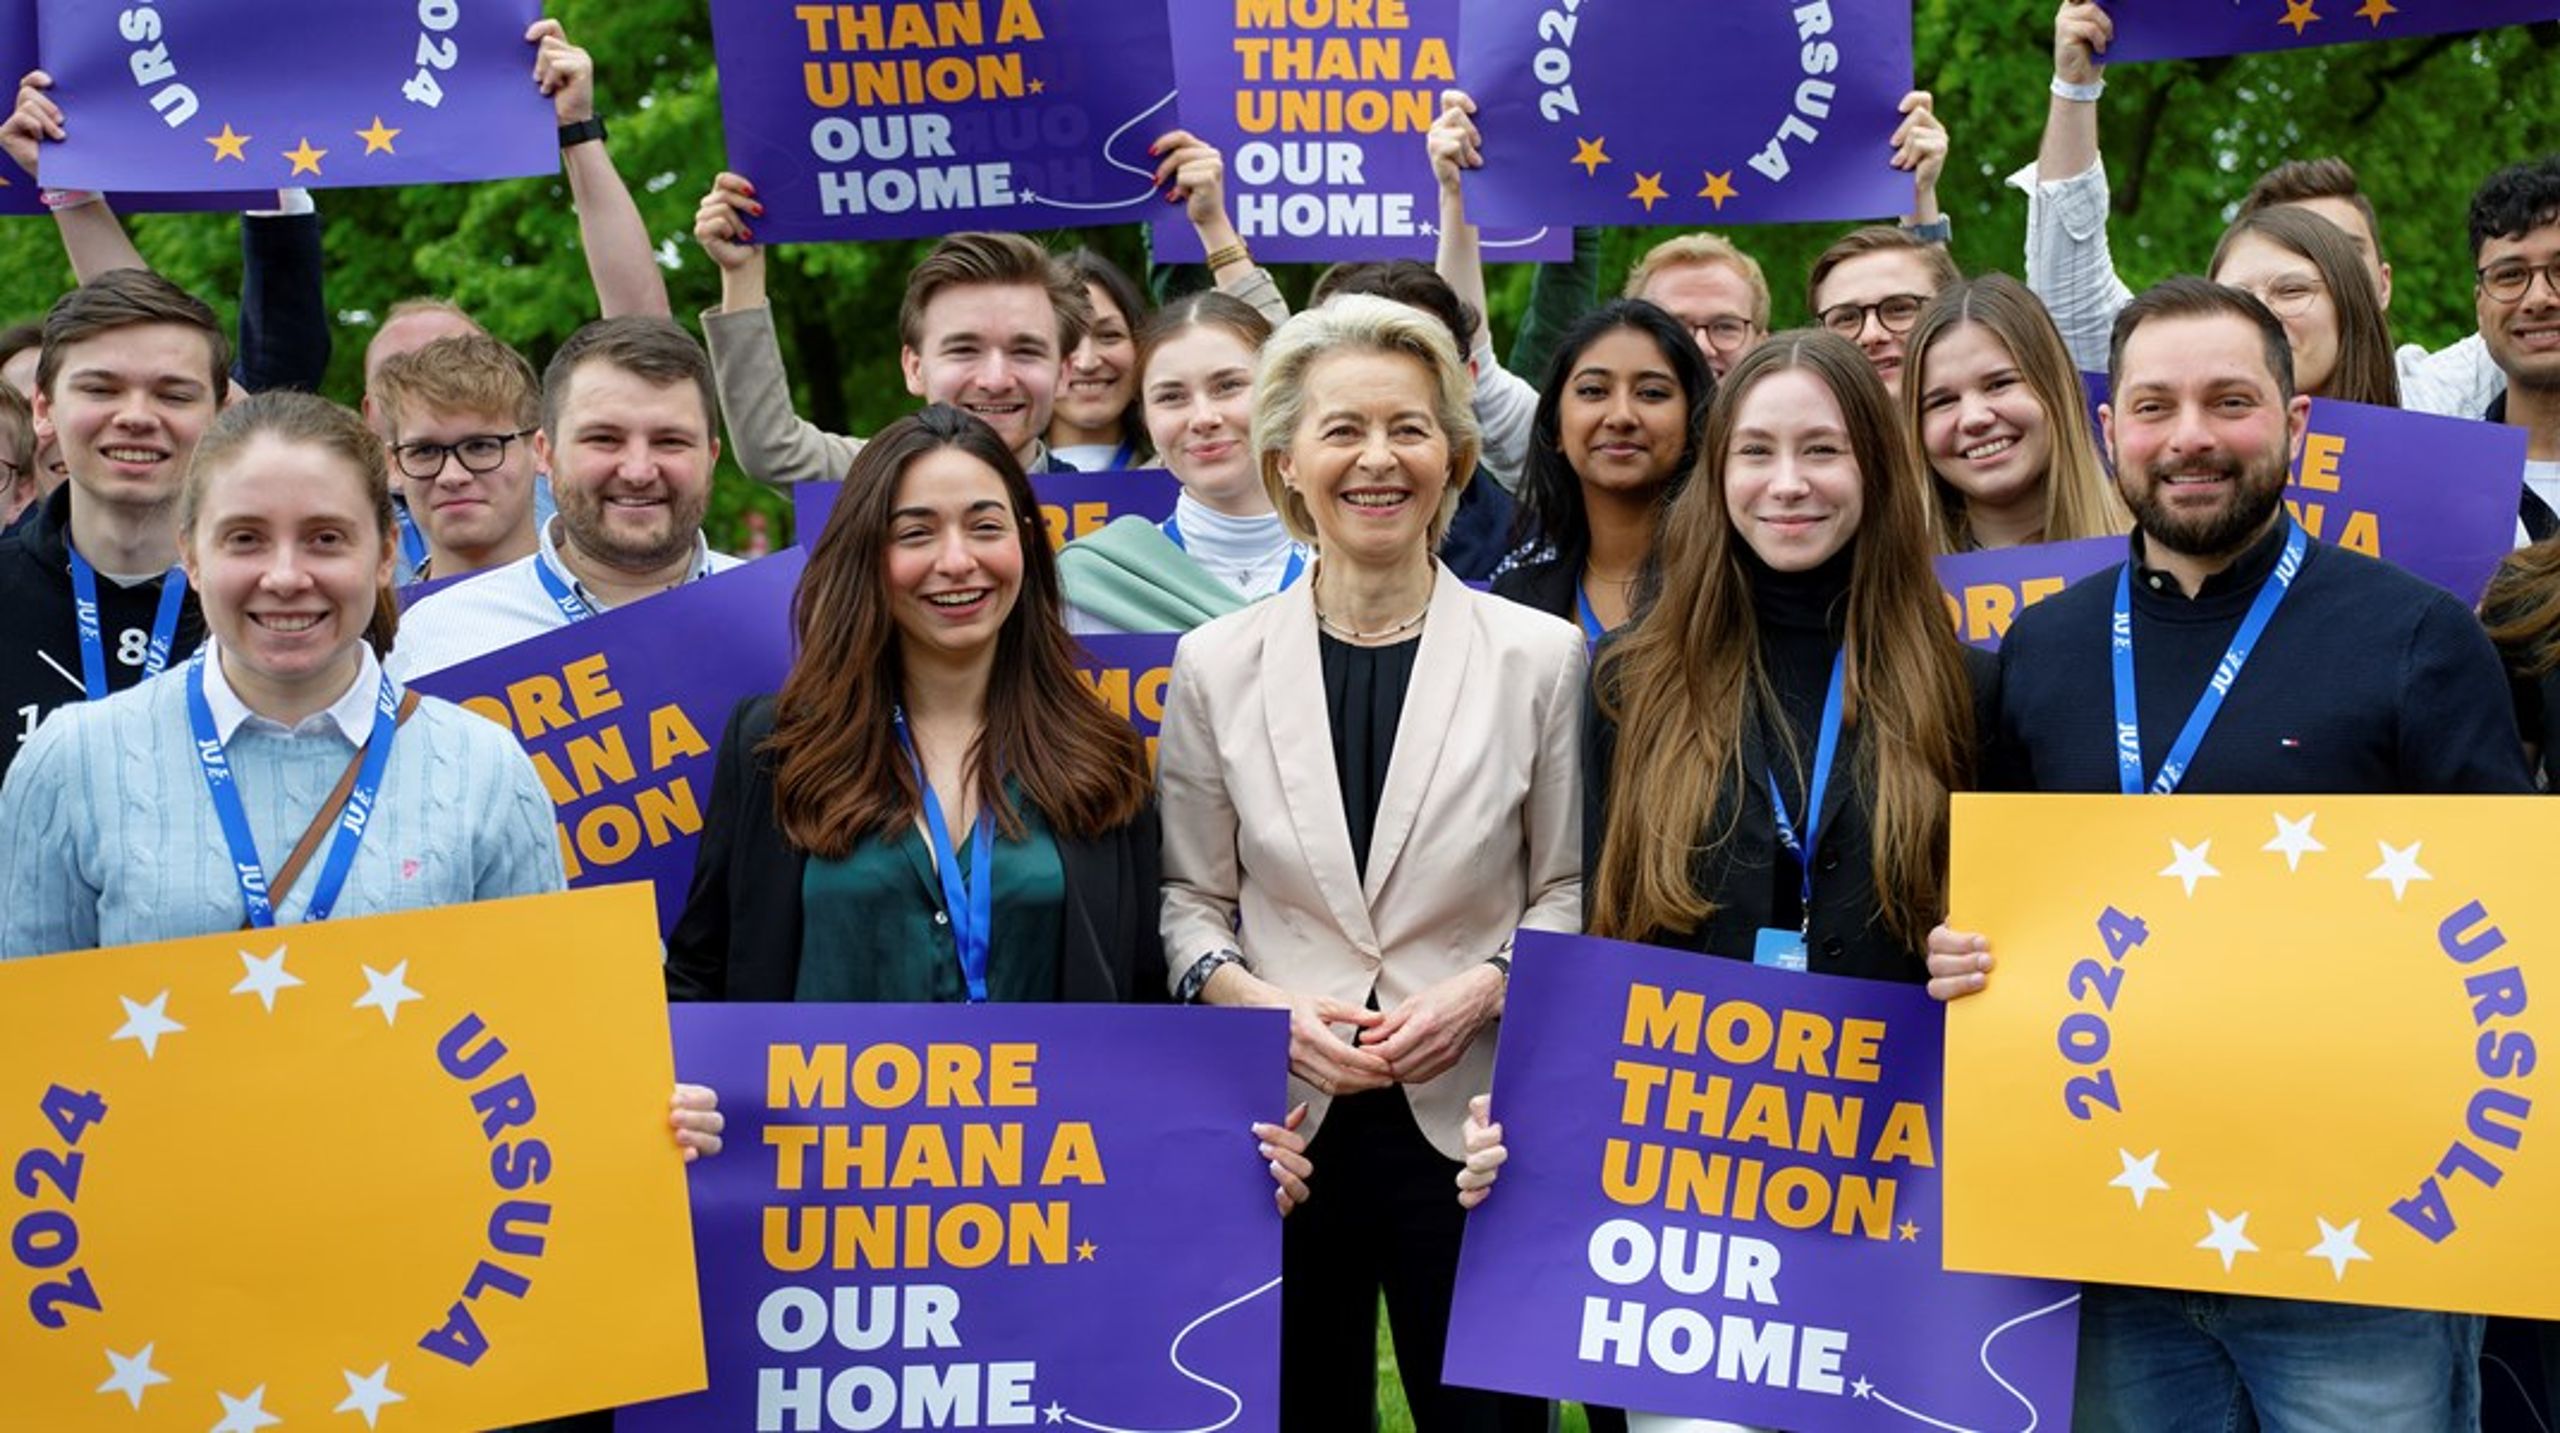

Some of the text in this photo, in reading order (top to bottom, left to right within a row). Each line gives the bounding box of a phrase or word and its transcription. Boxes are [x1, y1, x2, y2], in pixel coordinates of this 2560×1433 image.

[796, 0, 1043, 51] THAN A
[1236, 0, 1410, 29] MORE
[119, 0, 199, 128] URS
[1234, 38, 1455, 80] THAN A
[1747, 0, 1839, 182] RSULA
[810, 114, 956, 162] OUR
[1236, 90, 1433, 133] UNION
[1235, 141, 1366, 185] OUR
[116, 627, 149, 666] 8
[649, 703, 711, 771] A
[1622, 983, 1888, 1083] MORE
[2056, 904, 2150, 1121] 2024
[767, 1043, 1038, 1109] MORE
[2388, 899, 2538, 1244] URSULA
[1613, 1061, 1935, 1169] THAN A
[417, 1012, 553, 1367] URSULA
[763, 1122, 1106, 1190] THAN A
[11, 1082, 108, 1330] 2024
[1587, 1217, 1782, 1306] OUR
[756, 1284, 962, 1353] OUR
